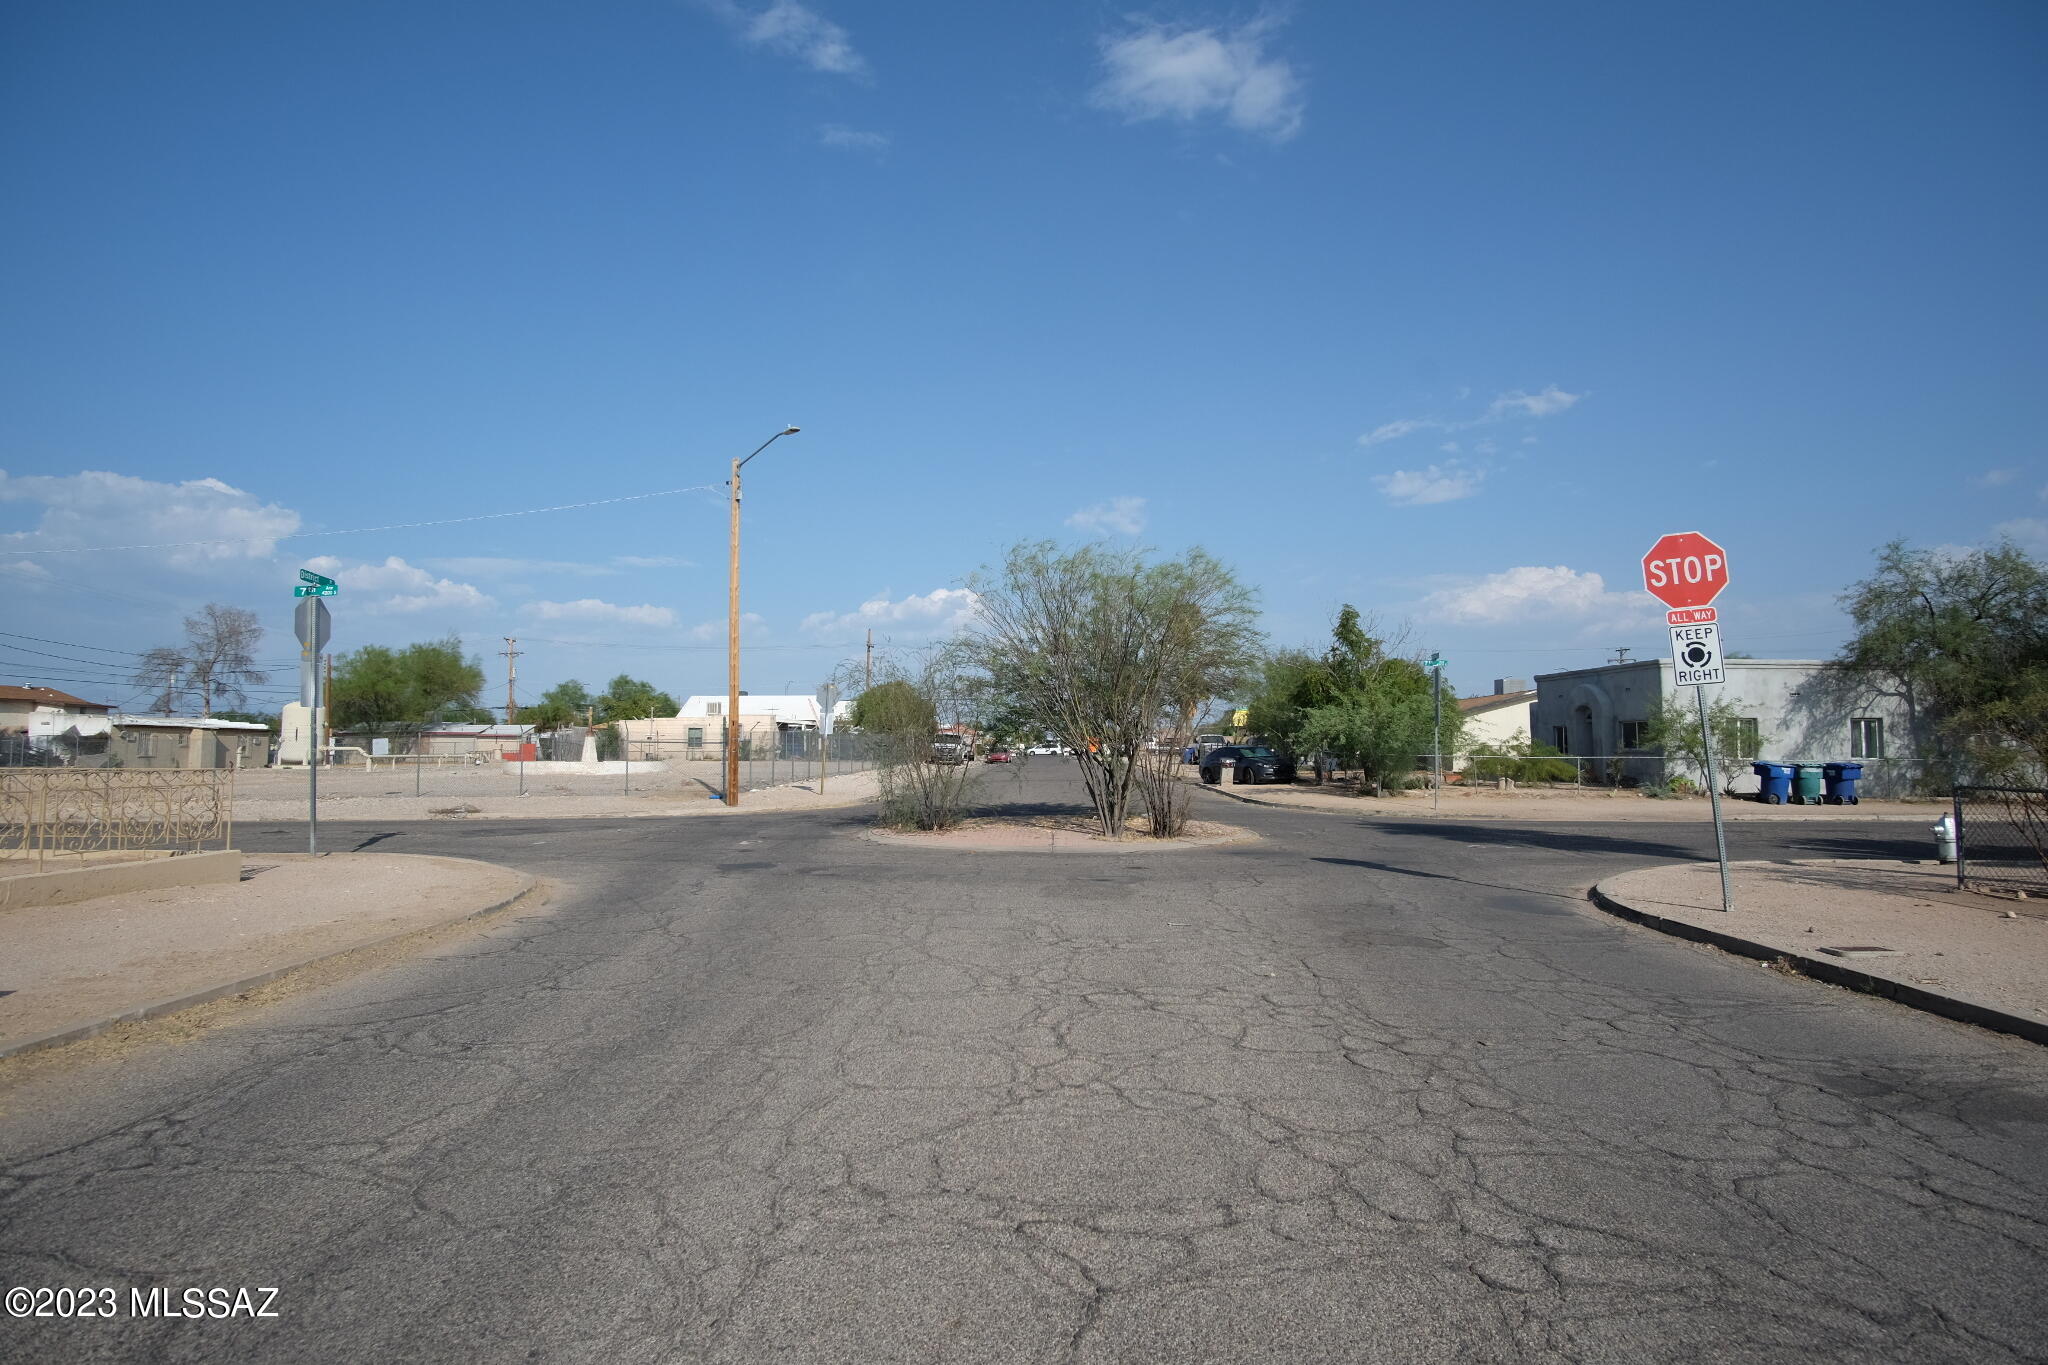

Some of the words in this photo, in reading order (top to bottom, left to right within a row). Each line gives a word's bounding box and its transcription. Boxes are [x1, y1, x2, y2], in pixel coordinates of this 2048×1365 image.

[1649, 554, 1722, 587] STOP
[1671, 613, 1689, 623] ALL
[1693, 610, 1712, 621] WAY
[1675, 627, 1713, 641] KEEP
[1679, 668, 1720, 682] RIGHT
